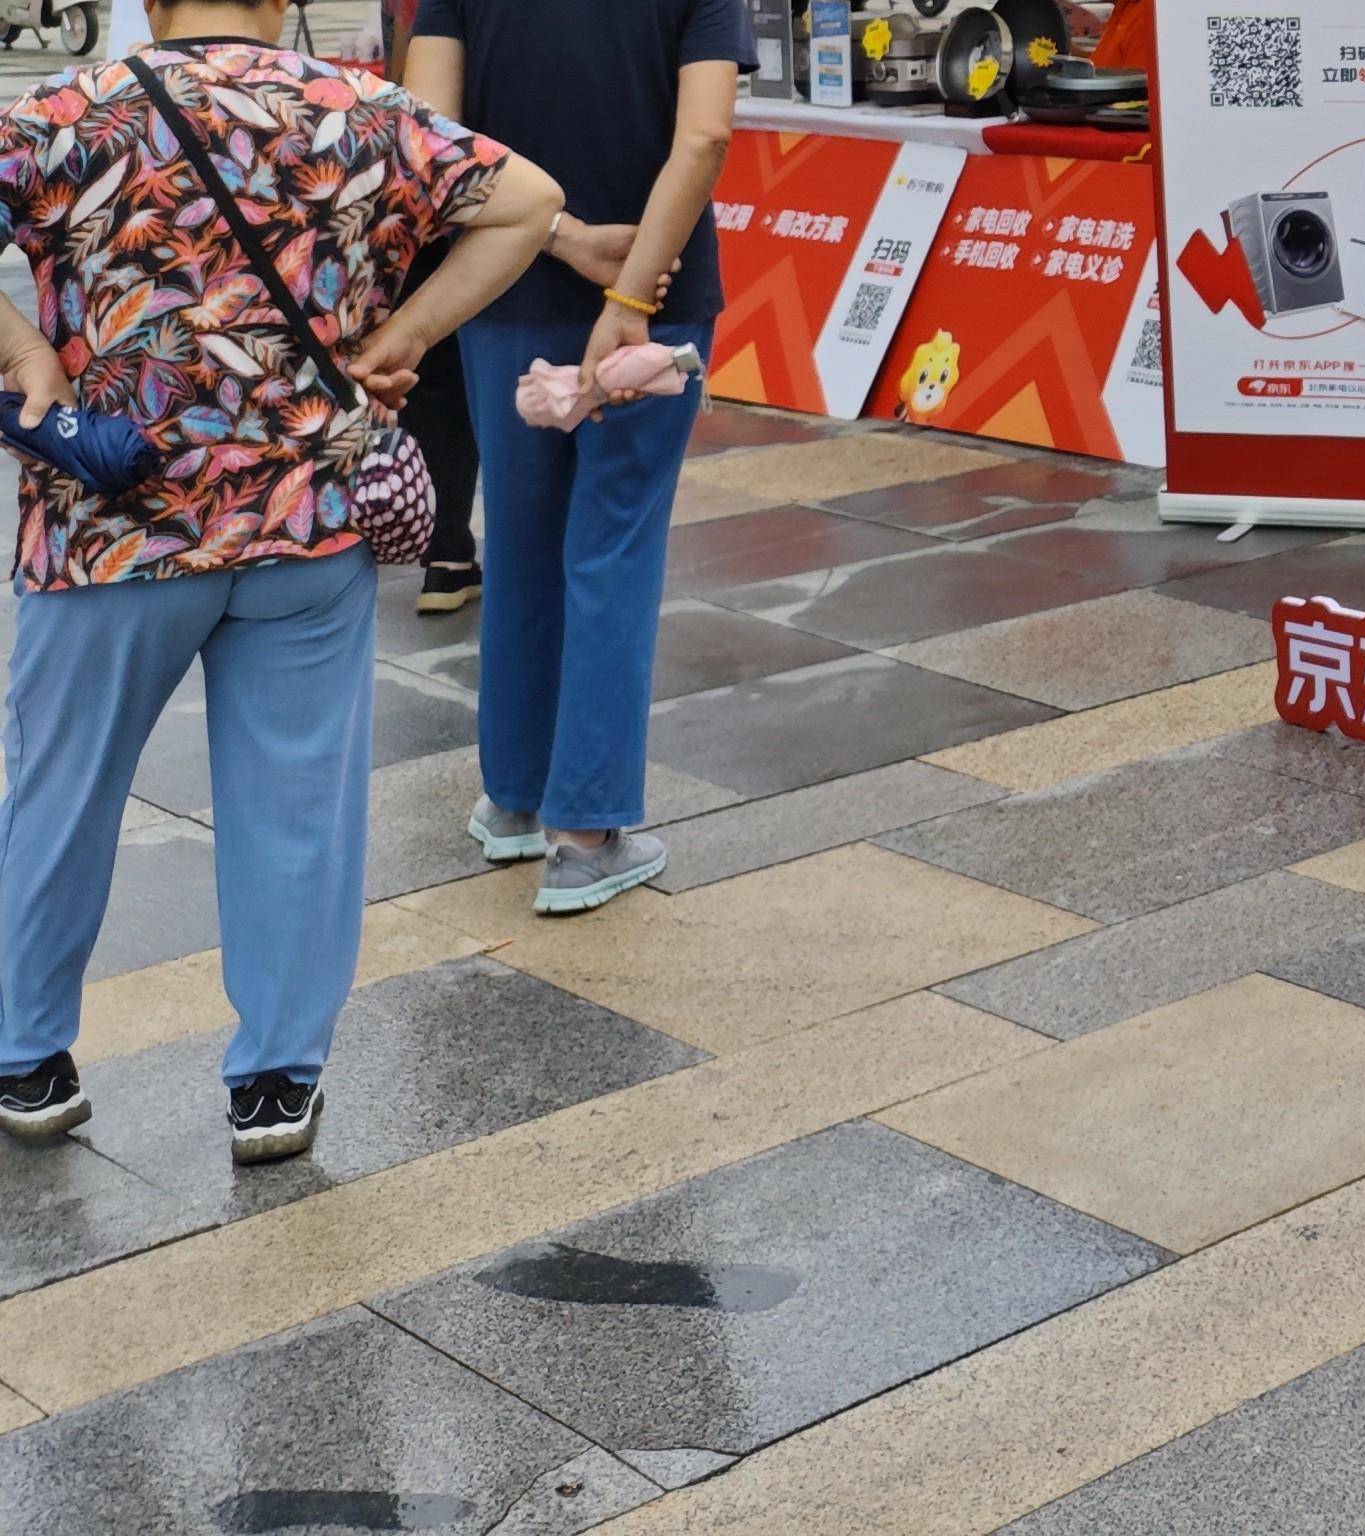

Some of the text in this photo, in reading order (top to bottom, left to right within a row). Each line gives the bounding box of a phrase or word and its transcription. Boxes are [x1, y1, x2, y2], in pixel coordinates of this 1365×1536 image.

[871, 236, 912, 264] 扫码
[965, 205, 1136, 252] 家电回收 家电清洗
[952, 238, 1125, 285] 手机回收 家电义诊
